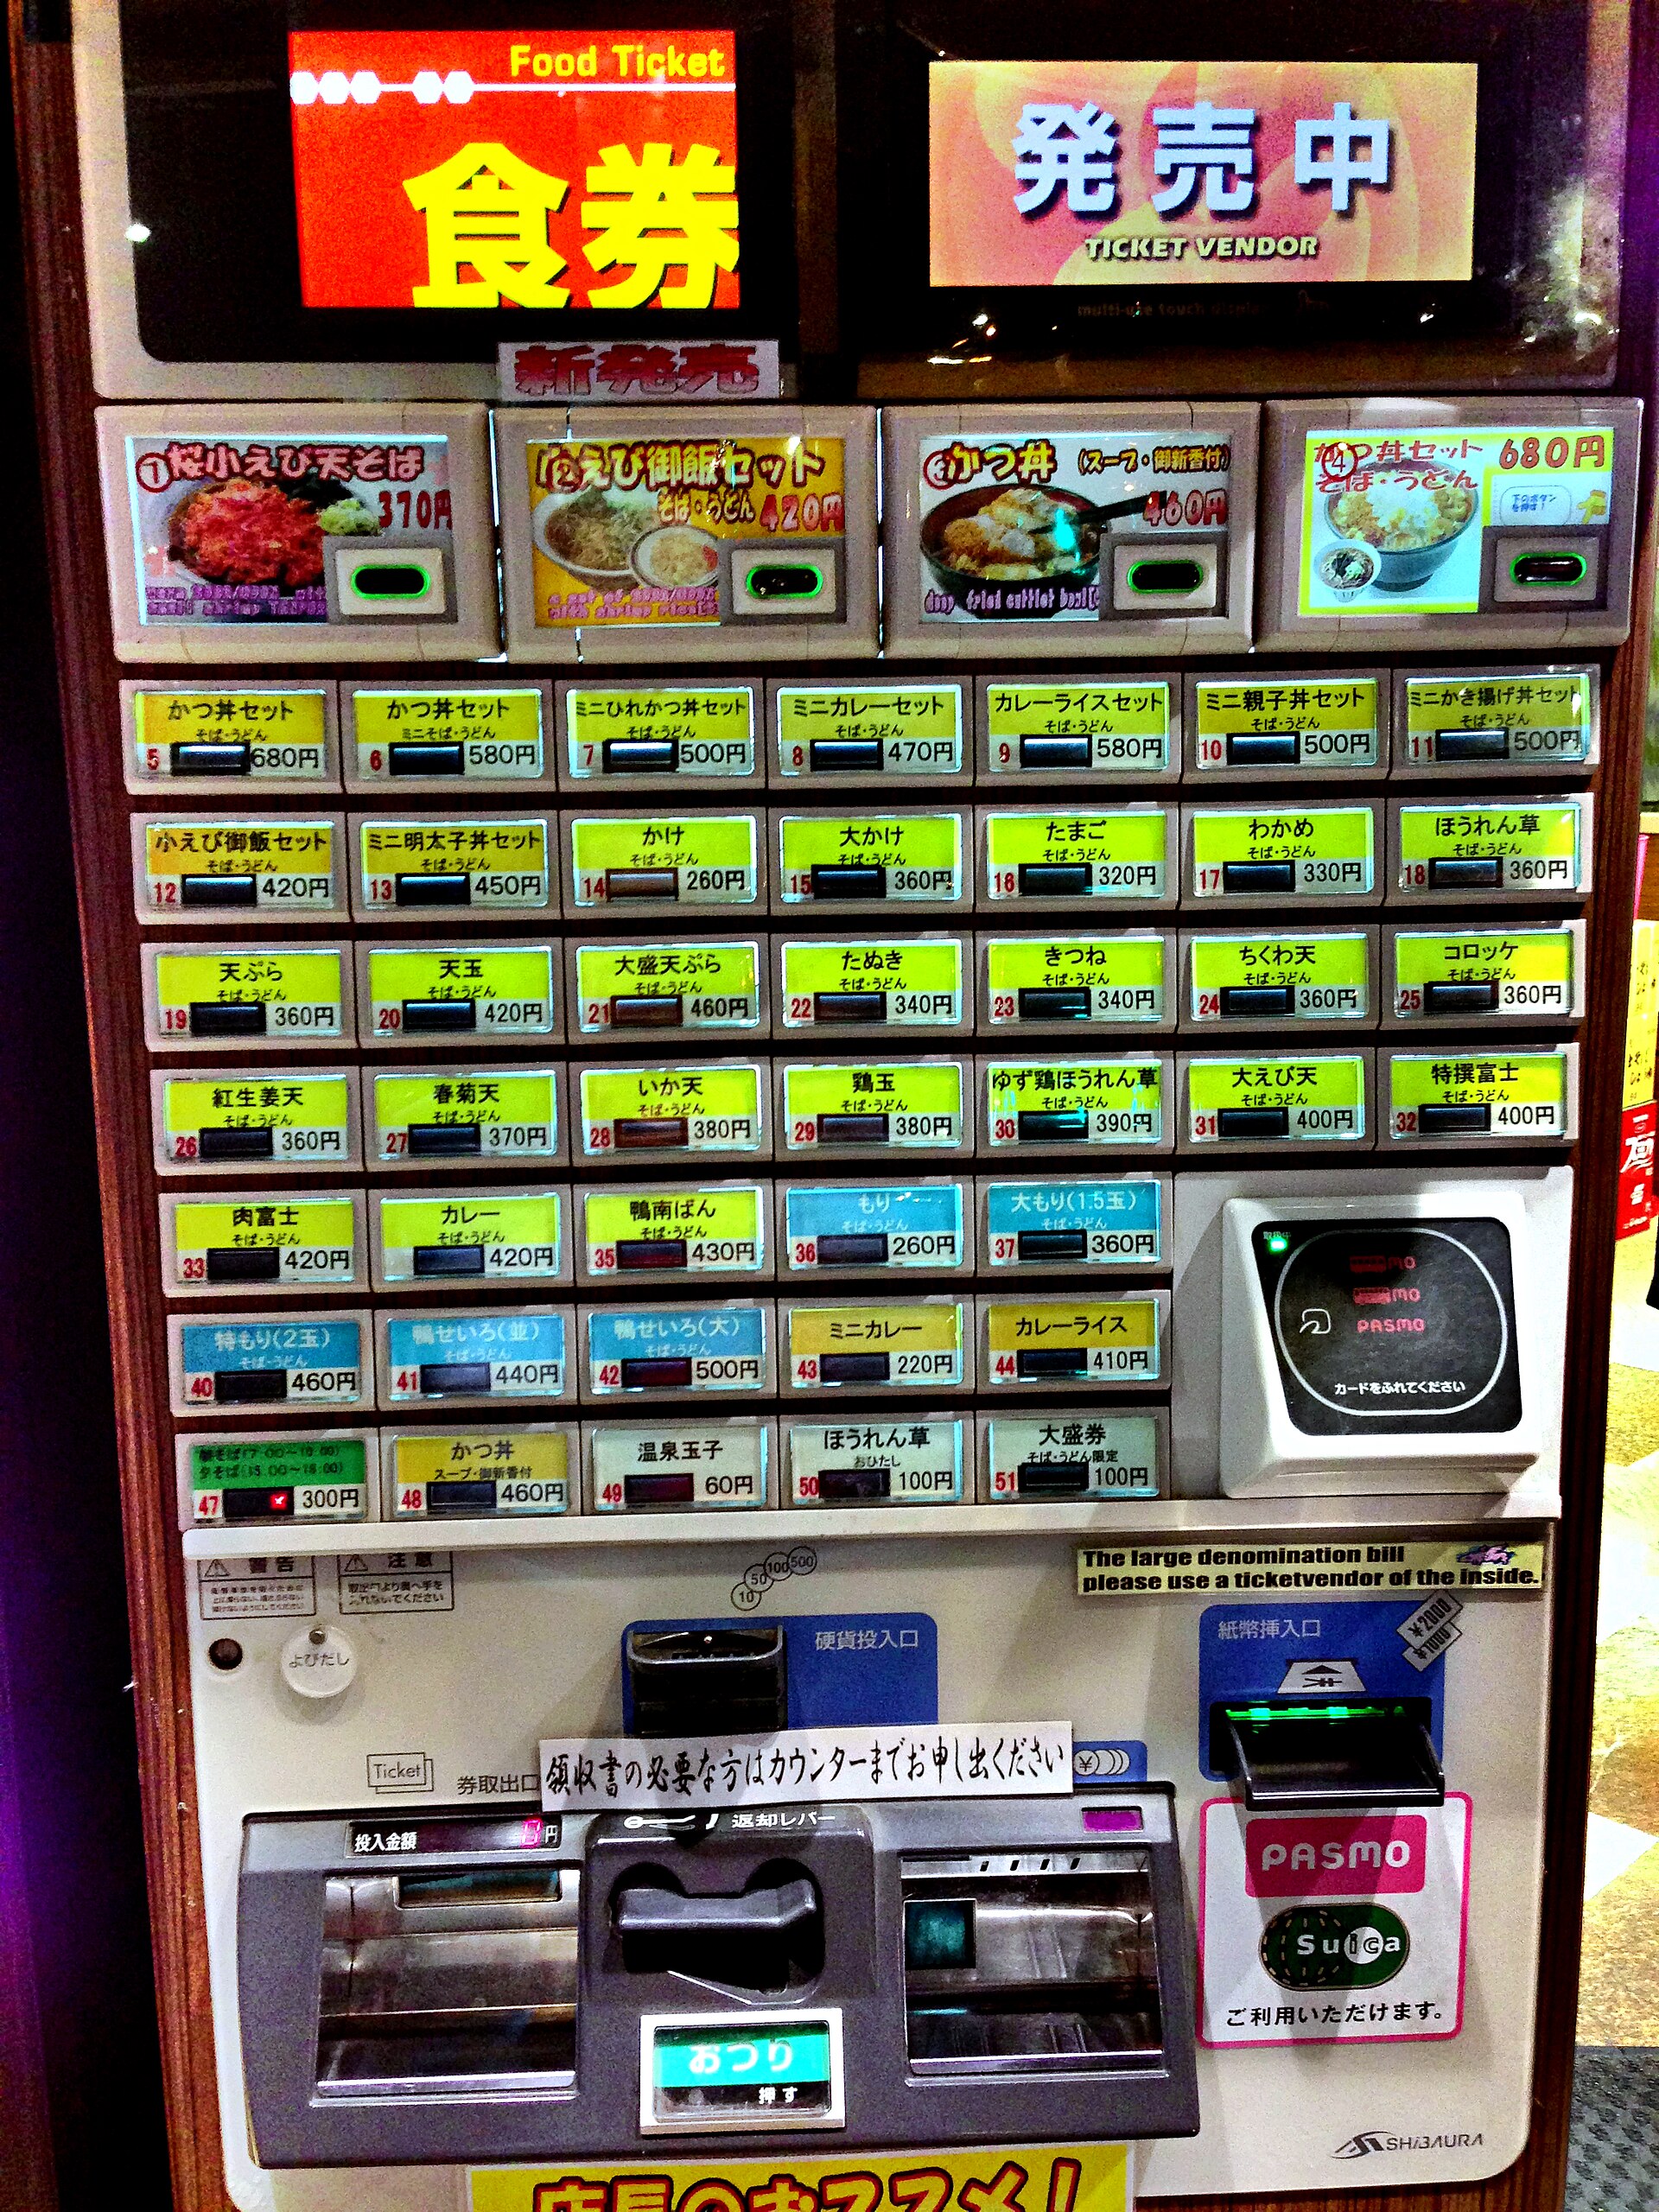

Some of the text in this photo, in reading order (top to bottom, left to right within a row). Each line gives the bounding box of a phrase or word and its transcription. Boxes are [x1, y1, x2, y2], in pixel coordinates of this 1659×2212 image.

[511, 45, 725, 77] Food Ticket
[1013, 100, 1392, 217] 発売中
[404, 143, 739, 308] 食券
[1086, 236, 1319, 260] TICKET VENDOR
[1159, 303, 1205, 316] touch
[514, 343, 760, 396] 新発売
[947, 439, 1056, 483] かつ丼
[1500, 435, 1605, 469] 680円
[378, 490, 451, 530] 370円
[761, 493, 844, 531] 420円
[1144, 490, 1227, 526] 460円
[387, 700, 509, 720] かつ丼セット
[576, 697, 746, 717] ミニひれかつ丼セット
[794, 697, 944, 715] ミニカレーセット
[995, 693, 1162, 713] カレーライスセット
[1206, 690, 1363, 711] ミニ親子丼セット
[168, 702, 292, 721] かつ丼セット
[1045, 720, 1113, 733] そば・うどん
[1097, 738, 1161, 759] 580円
[1305, 734, 1370, 754] 500円
[1514, 729, 1580, 751] 500円
[251, 748, 318, 768] 680円
[469, 745, 534, 766] 580円
[681, 743, 746, 764] 500円
[888, 742, 953, 762] 470円
[1046, 821, 1105, 842] たまご
[1249, 819, 1313, 840] わかめ
[1436, 815, 1540, 836] ほうれん草
[156, 830, 326, 852] 小えび御飯セット
[369, 831, 539, 850] ミニ明太子丼セット
[644, 827, 683, 846] かけ
[840, 826, 904, 846] 大かけ
[688, 870, 745, 891] 260円
[895, 870, 951, 889] 360円
[1099, 865, 1156, 886] 320円
[1304, 862, 1361, 882] 330円
[1510, 861, 1567, 880] 360円
[263, 878, 328, 898] 420円
[475, 876, 540, 895] 450円
[842, 950, 903, 971] たぬき
[1045, 945, 1107, 965] きつね
[1240, 945, 1316, 964] ちくわ天
[1445, 941, 1518, 961] コロッケ
[220, 962, 283, 982] 天ぷら
[440, 959, 482, 979] 天玉
[615, 955, 721, 976] 大盛天ぷら
[895, 995, 952, 1015] 340円
[1099, 989, 1154, 1010] 340円
[1300, 988, 1357, 1008] 360円
[1504, 985, 1561, 1005] 360円
[276, 1006, 334, 1027] 360円
[485, 1003, 542, 1024] 420円
[691, 998, 748, 1018] 460円
[639, 1076, 702, 1096] いか天
[853, 1072, 895, 1093] 鶏玉
[993, 1067, 1158, 1090] ゆず鶏ほうれん草
[1232, 1067, 1317, 1088] 大えび天
[212, 1087, 303, 1108] 紅生姜天
[434, 1084, 500, 1103] 春菊天
[1096, 1112, 1152, 1133] 390円
[1297, 1109, 1353, 1129] 400円
[1498, 1105, 1554, 1126] 400円
[694, 1119, 750, 1139] 380円
[896, 1116, 952, 1136] 380円
[282, 1131, 340, 1151] 360円
[489, 1127, 547, 1147] 370円
[630, 1199, 715, 1221] 鴨南ばん
[858, 1194, 891, 1214] もり
[233, 1207, 298, 1227] 肉富士
[442, 1205, 499, 1224] カレー
[692, 1243, 754, 1262] 430円
[893, 1236, 955, 1255] 260円
[1092, 1234, 1154, 1254] 360円
[285, 1250, 350, 1270] 420円
[489, 1247, 553, 1267] 420円
[831, 1320, 922, 1338] ミニカレー
[1016, 1316, 1128, 1337] カレーライス
[1357, 1319, 1425, 1332] PASMO
[215, 1329, 330, 1351] 特もり(2玉)
[696, 1360, 759, 1380] 500円
[898, 1355, 952, 1374] 220円
[1094, 1351, 1148, 1370] 410円
[292, 1371, 356, 1391] 460円
[496, 1364, 558, 1384] 440円
[1334, 1381, 1465, 1395] カードをふれてください
[824, 1427, 931, 1450] ほうれん草
[1039, 1424, 1107, 1446] 大盛券
[452, 1440, 514, 1461] かつ丼
[638, 1440, 723, 1462] 温泉玉子
[706, 1474, 753, 1496] 60円
[899, 1471, 953, 1492] 100円
[1095, 1466, 1148, 1487] 100円
[302, 1488, 359, 1509] 300円
[501, 1484, 563, 1503] 460円
[768, 1561, 788, 1573] 100
[791, 1556, 813, 1567] 500
[1084, 1547, 1404, 1568] The large denomination bill
[751, 1573, 766, 1585] 50
[1084, 1567, 1539, 1592] please use a ticketvendor of the inside.
[739, 1591, 753, 1603] 10
[1408, 1598, 1452, 1637] ¥2000
[1218, 1619, 1321, 1639] 紙幣挿入口
[815, 1630, 918, 1650] 硬貨投入口
[289, 1649, 350, 1668] よびだし
[373, 1764, 422, 1779] Ticket
[457, 1775, 538, 1796] 券取出口
[732, 1812, 836, 1828] 返却レバー
[355, 1833, 416, 1851] 投入金額
[1262, 1840, 1411, 1872] PASMO
[1297, 1934, 1401, 1955] Suica
[1227, 2000, 1443, 2027] ご利用いただけます。
[689, 2039, 794, 2075] おつり
[758, 2086, 798, 2105] 押す
